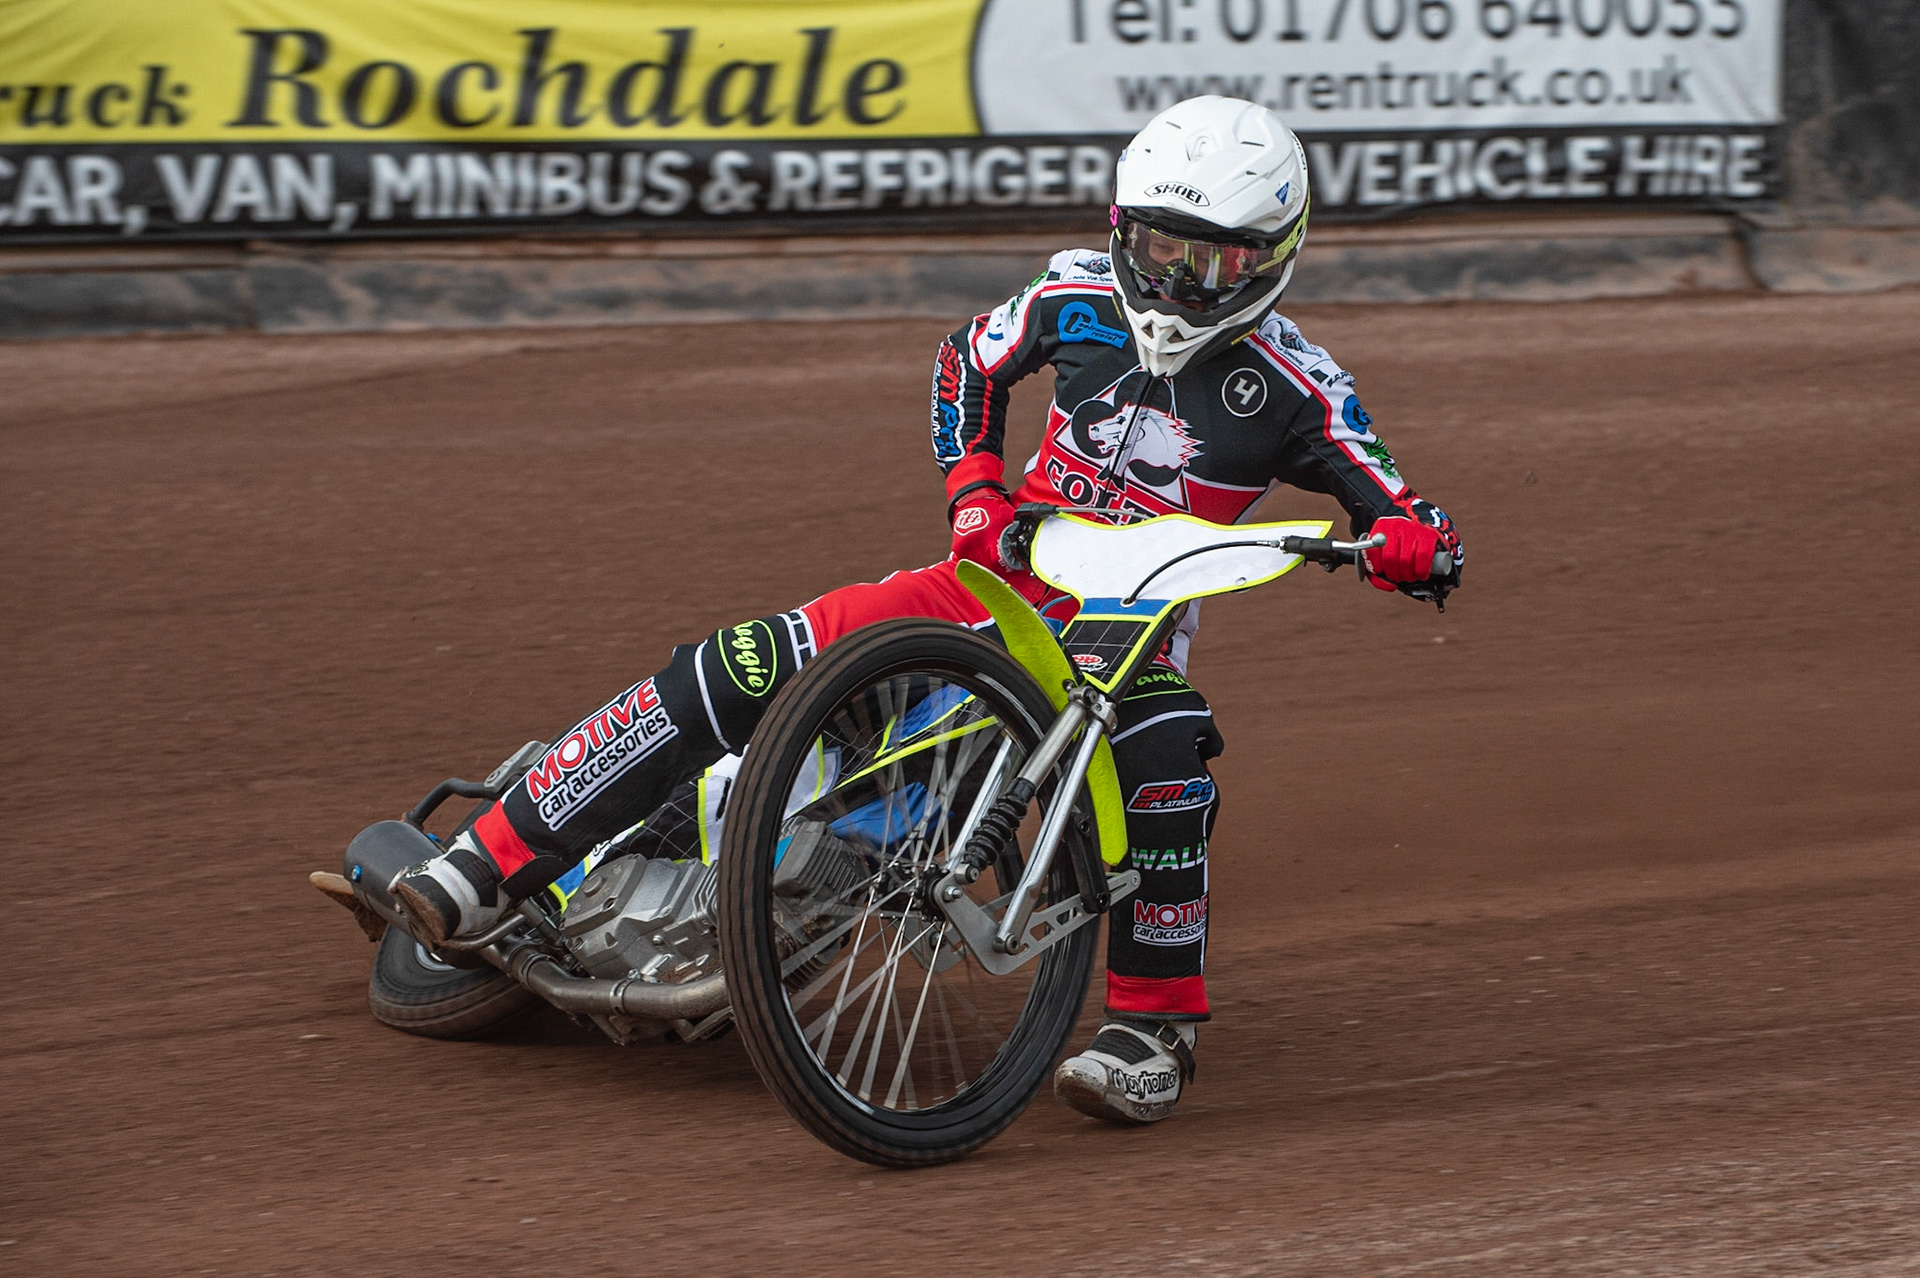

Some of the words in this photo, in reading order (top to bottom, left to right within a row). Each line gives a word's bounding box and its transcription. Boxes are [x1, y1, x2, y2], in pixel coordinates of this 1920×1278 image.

[1218, 0, 1454, 42] 01706
[1478, 0, 1747, 40] 640055
[0, 64, 191, 128] uck
[222, 26, 907, 130] Rochdale
[154, 153, 358, 233] VAN,
[368, 150, 692, 218] MINIBUS
[705, 149, 761, 215] &
[1312, 136, 1611, 206] VEHICLE
[1622, 134, 1768, 198] HIRE
[1152, 183, 1202, 204] SHOEI
[1233, 377, 1260, 406] 4
[527, 677, 660, 801] MOTIVE
[541, 787, 573, 820] car
[570, 711, 668, 795] accessories
[1131, 841, 1206, 870] WALL
